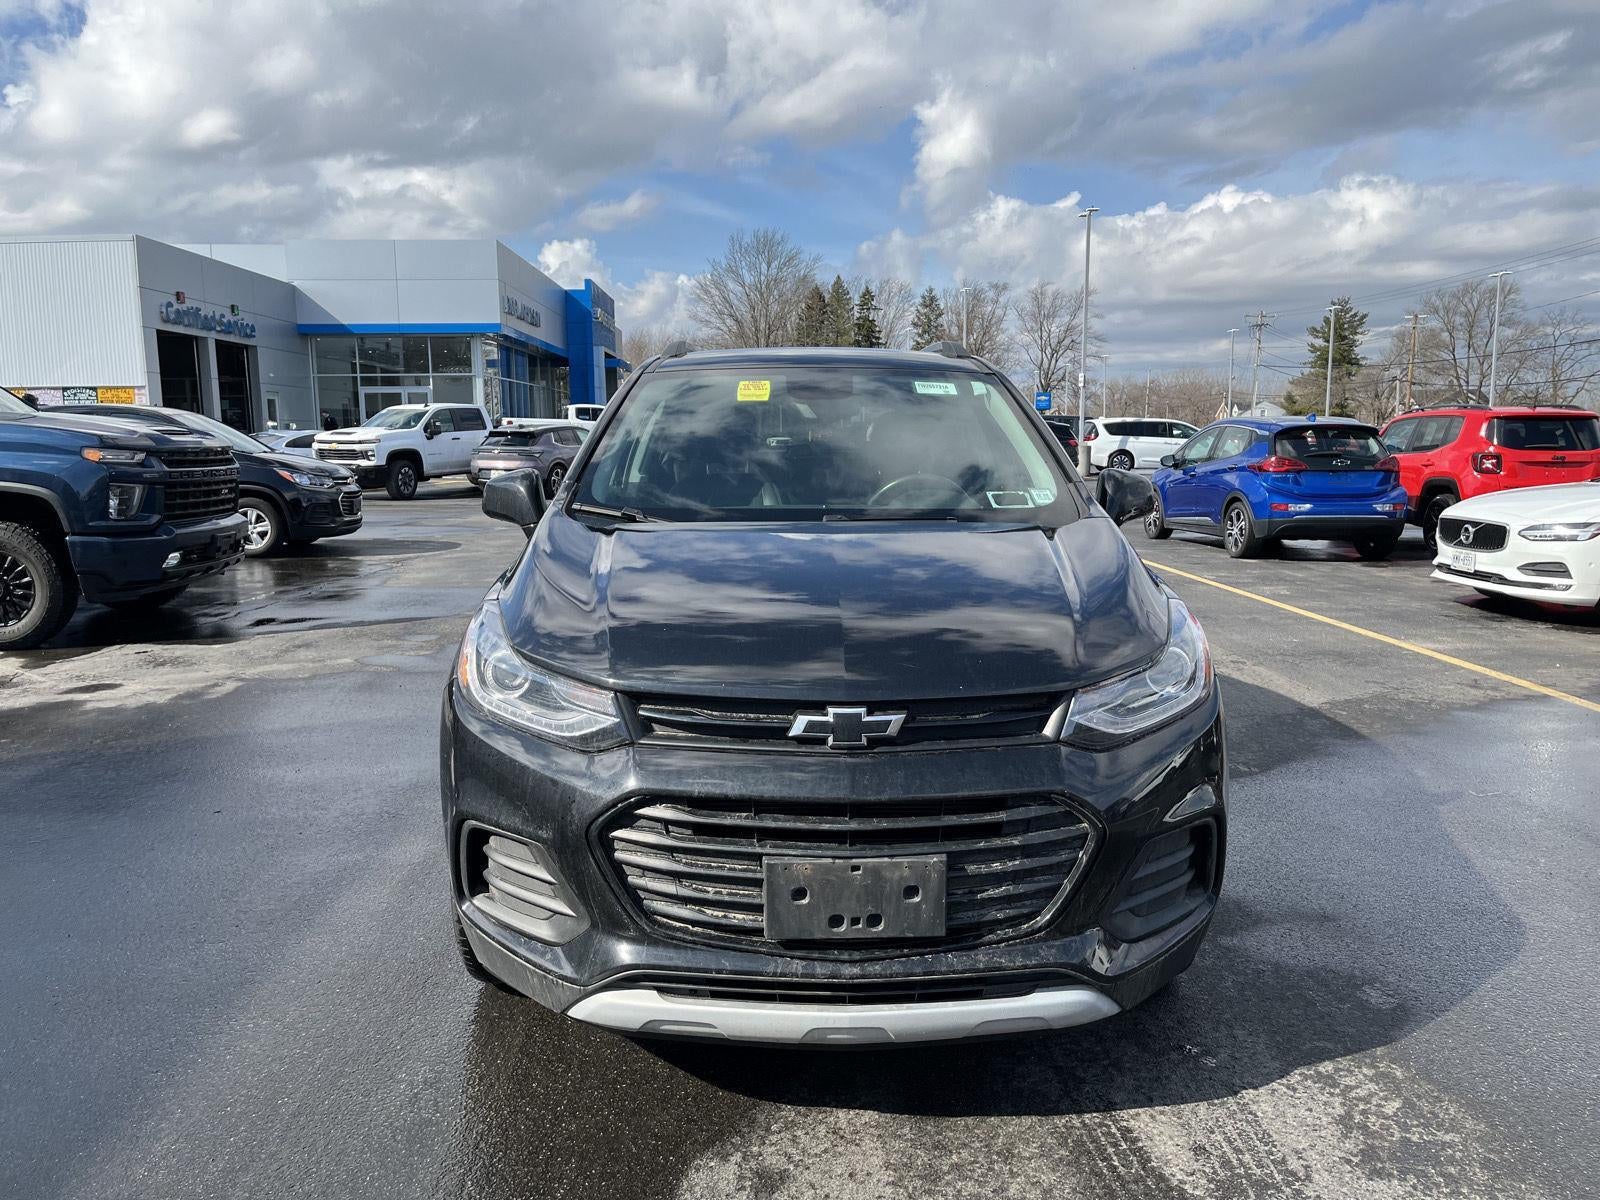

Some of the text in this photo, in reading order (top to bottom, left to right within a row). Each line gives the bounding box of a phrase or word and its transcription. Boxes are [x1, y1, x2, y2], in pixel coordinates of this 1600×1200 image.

[162, 301, 256, 338] Certified Service
[63, 387, 97, 397] REGISTERED
